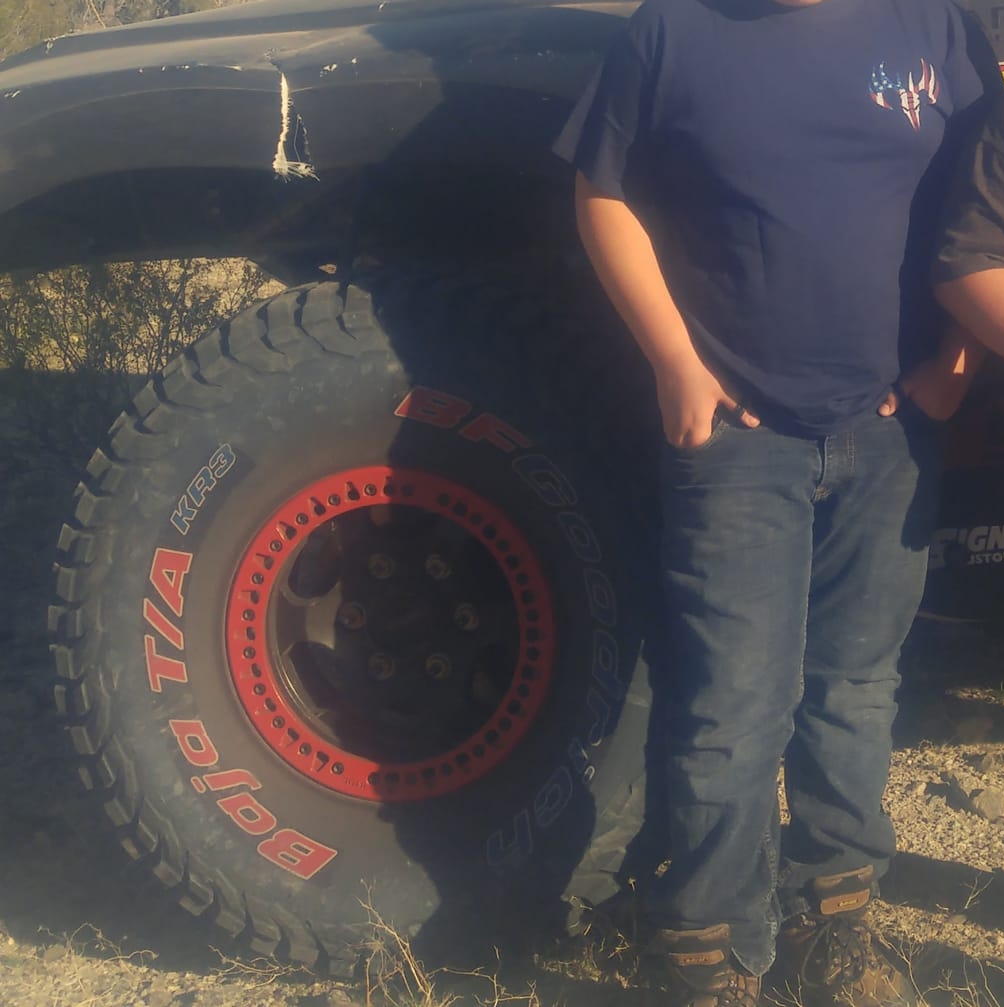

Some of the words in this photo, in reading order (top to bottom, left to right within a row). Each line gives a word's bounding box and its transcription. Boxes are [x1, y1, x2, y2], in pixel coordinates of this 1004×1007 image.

[169, 442, 238, 536] KR3
[143, 547, 193, 693] T/A
[169, 719, 338, 880] Baja
